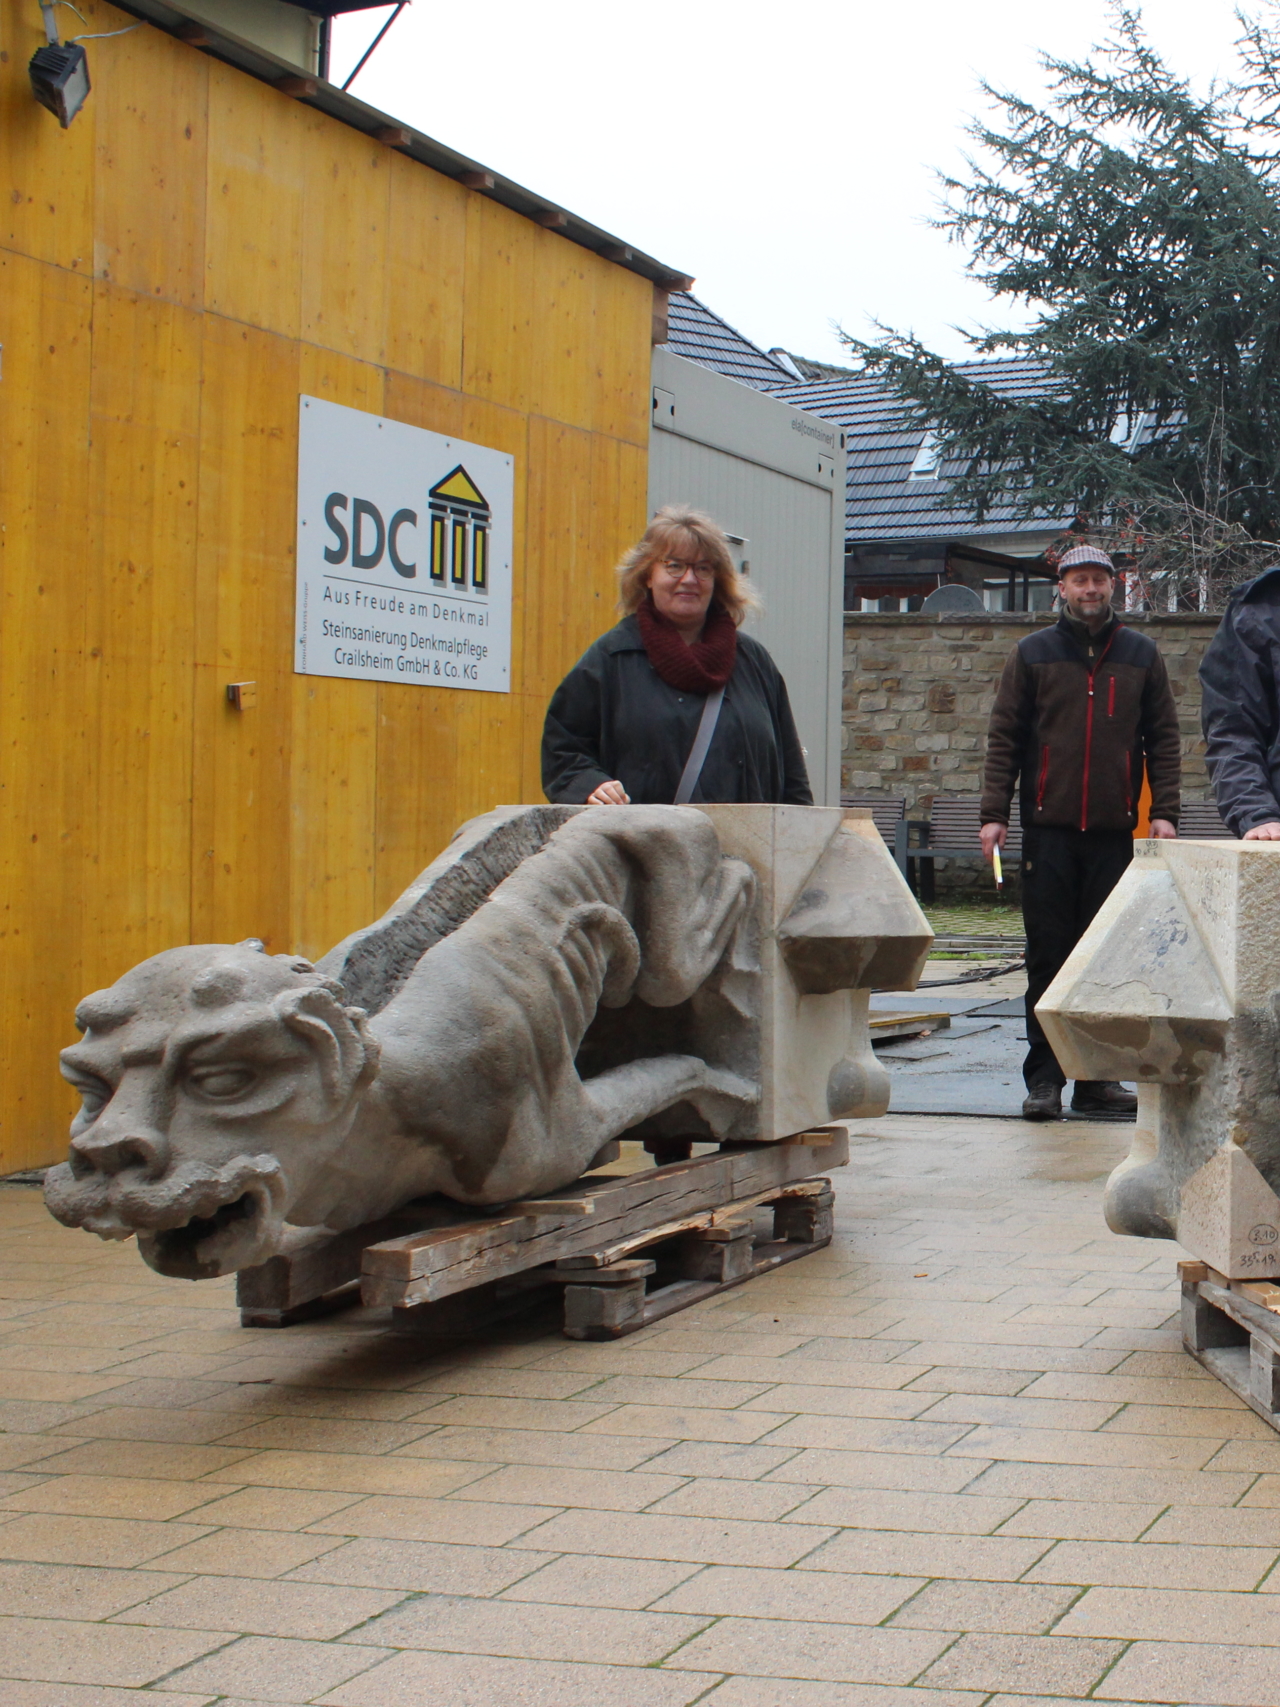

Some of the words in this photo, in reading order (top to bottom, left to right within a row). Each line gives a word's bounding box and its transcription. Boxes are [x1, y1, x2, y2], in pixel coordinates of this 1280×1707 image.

[323, 491, 418, 579] SDC
[323, 585, 350, 606] Aus
[355, 590, 405, 614] Freude
[409, 603, 428, 617] am
[433, 603, 489, 627] Denkmal
[322, 619, 408, 651] Steinsanierung
[410, 631, 488, 661] Denkmalpflege
[334, 647, 394, 671] Crailsheim
[396, 655, 430, 675] GmbH
[433, 659, 441, 676] &
[444, 661, 460, 678] Co.
[463, 663, 478, 680] KG
